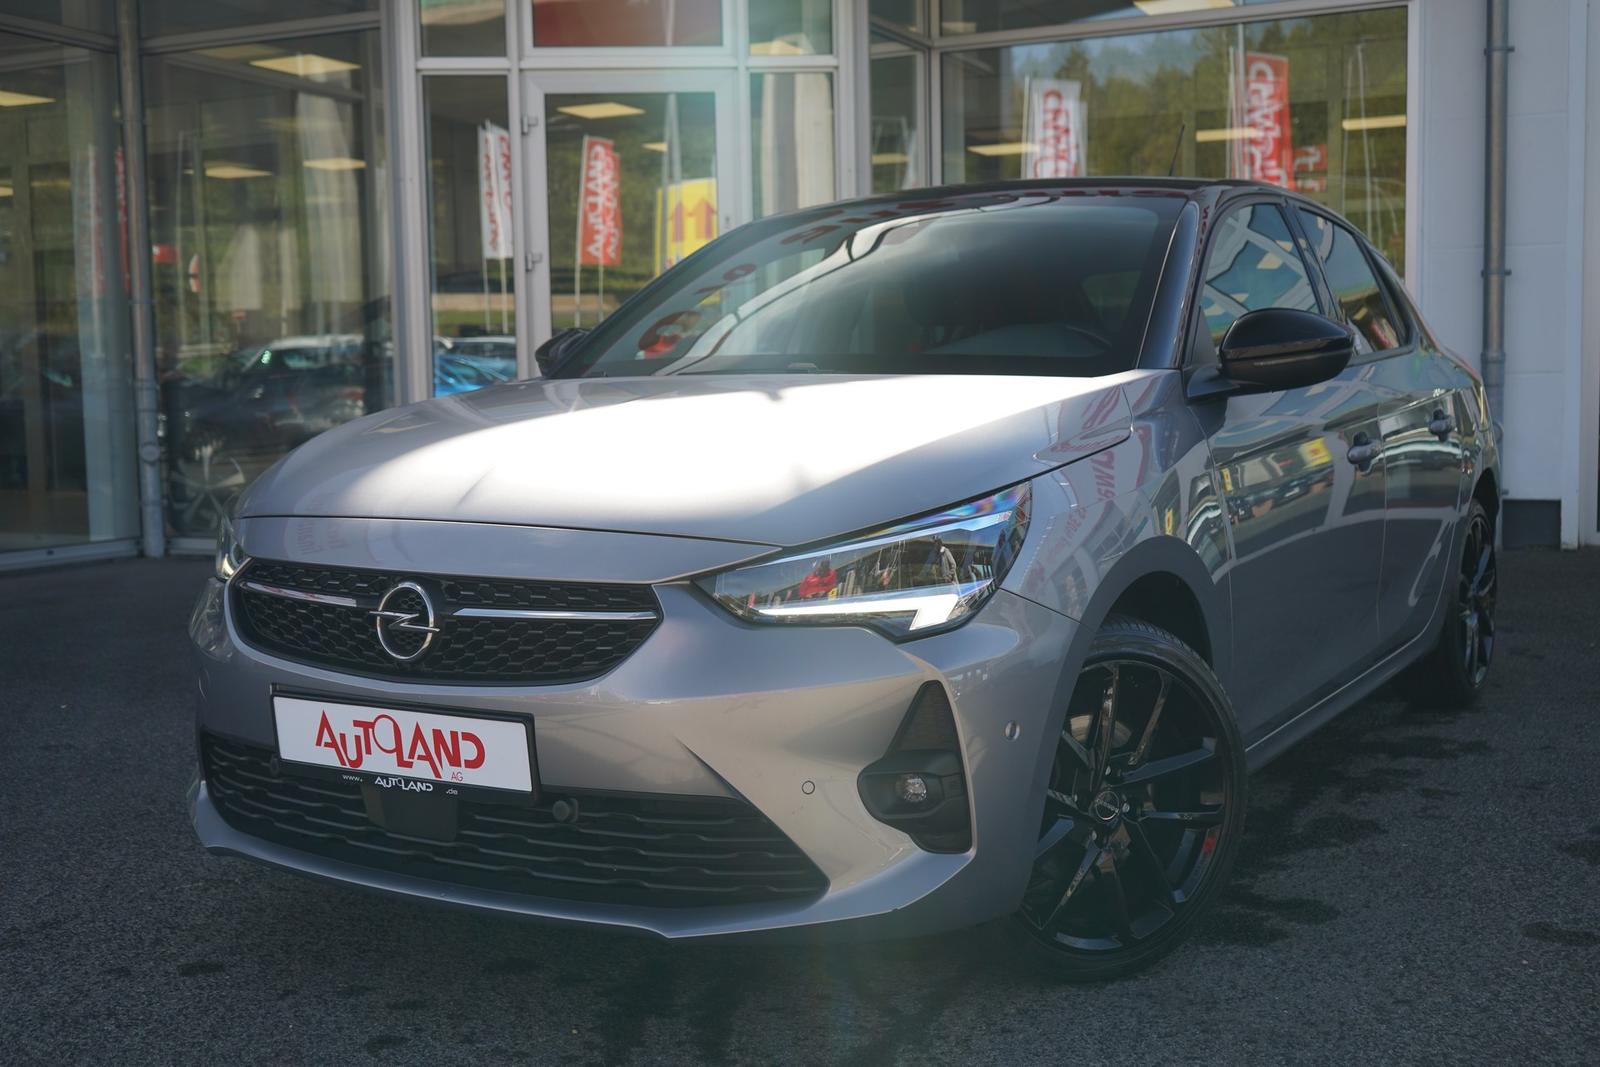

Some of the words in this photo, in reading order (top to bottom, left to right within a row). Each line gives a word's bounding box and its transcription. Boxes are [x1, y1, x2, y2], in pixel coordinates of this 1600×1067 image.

[315, 710, 485, 778] AUTOLAND
[374, 776, 434, 793] AUTOLAND
[445, 788, 459, 796] .de
[450, 771, 464, 782] AG
